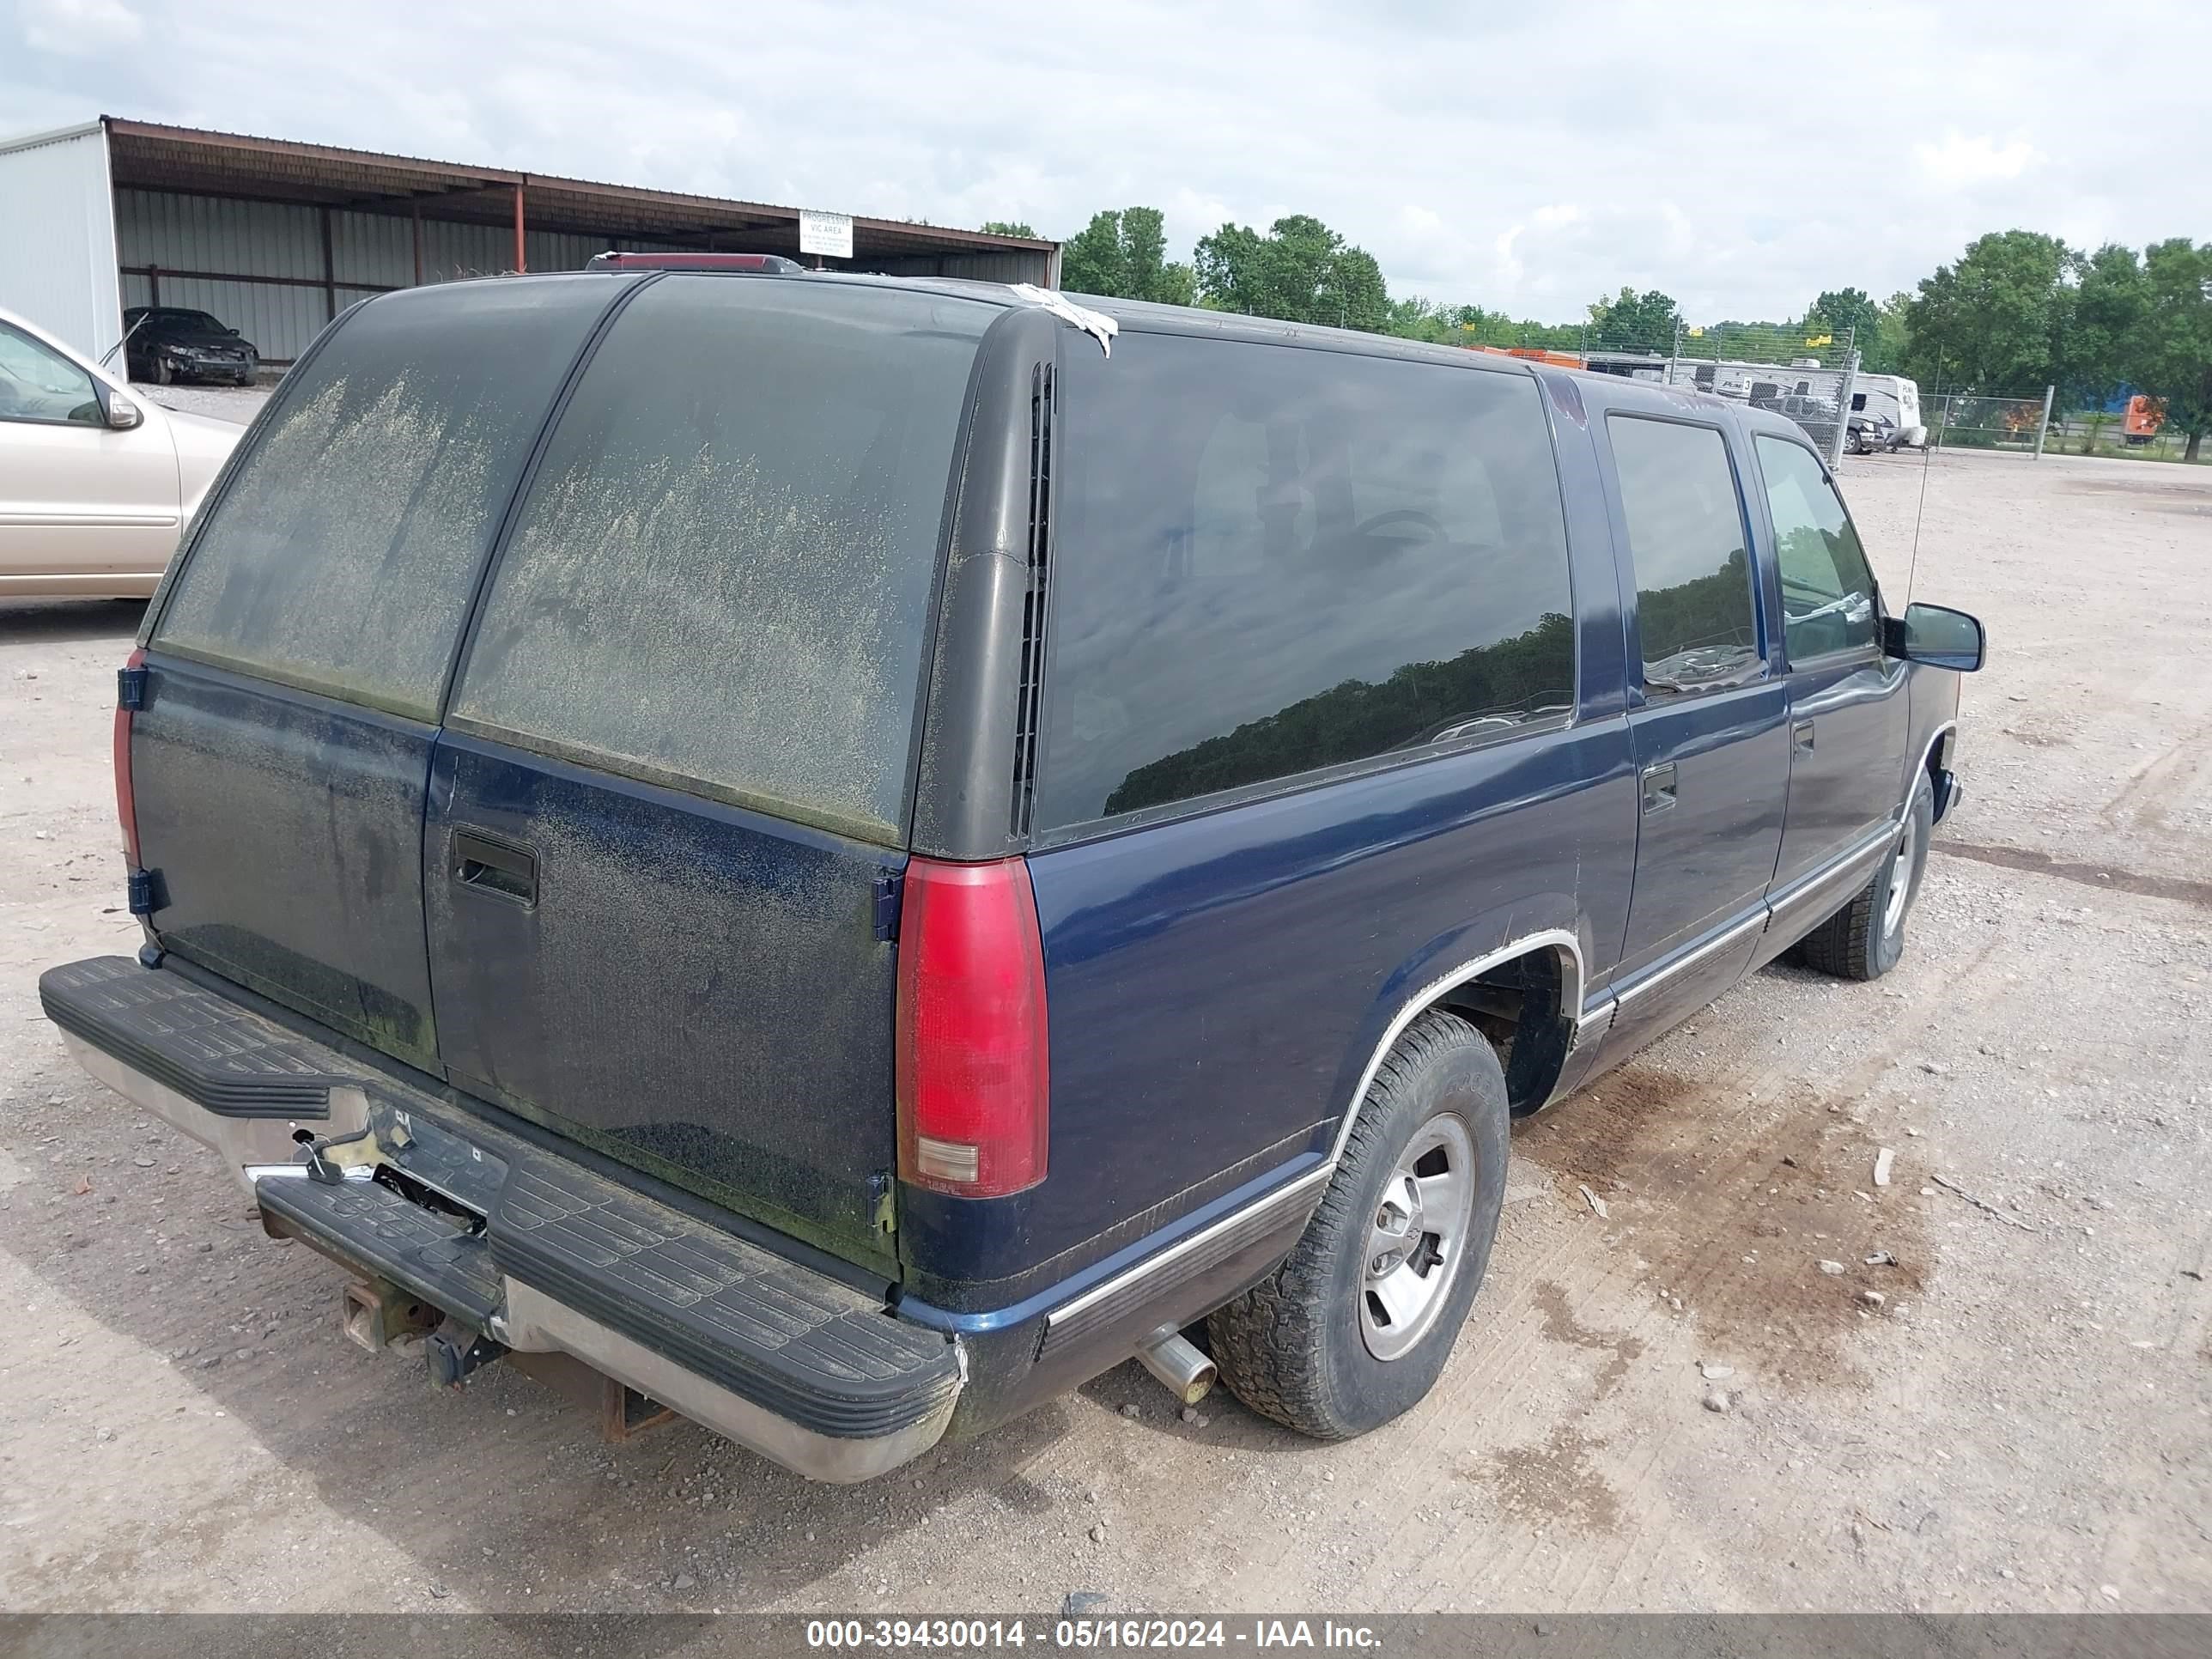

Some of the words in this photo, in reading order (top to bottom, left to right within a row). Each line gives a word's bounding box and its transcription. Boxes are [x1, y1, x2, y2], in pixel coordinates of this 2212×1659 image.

[802, 212, 851, 227] PROGRESSIVE
[823, 226, 842, 234] AREA
[1745, 380, 1750, 390] 3
